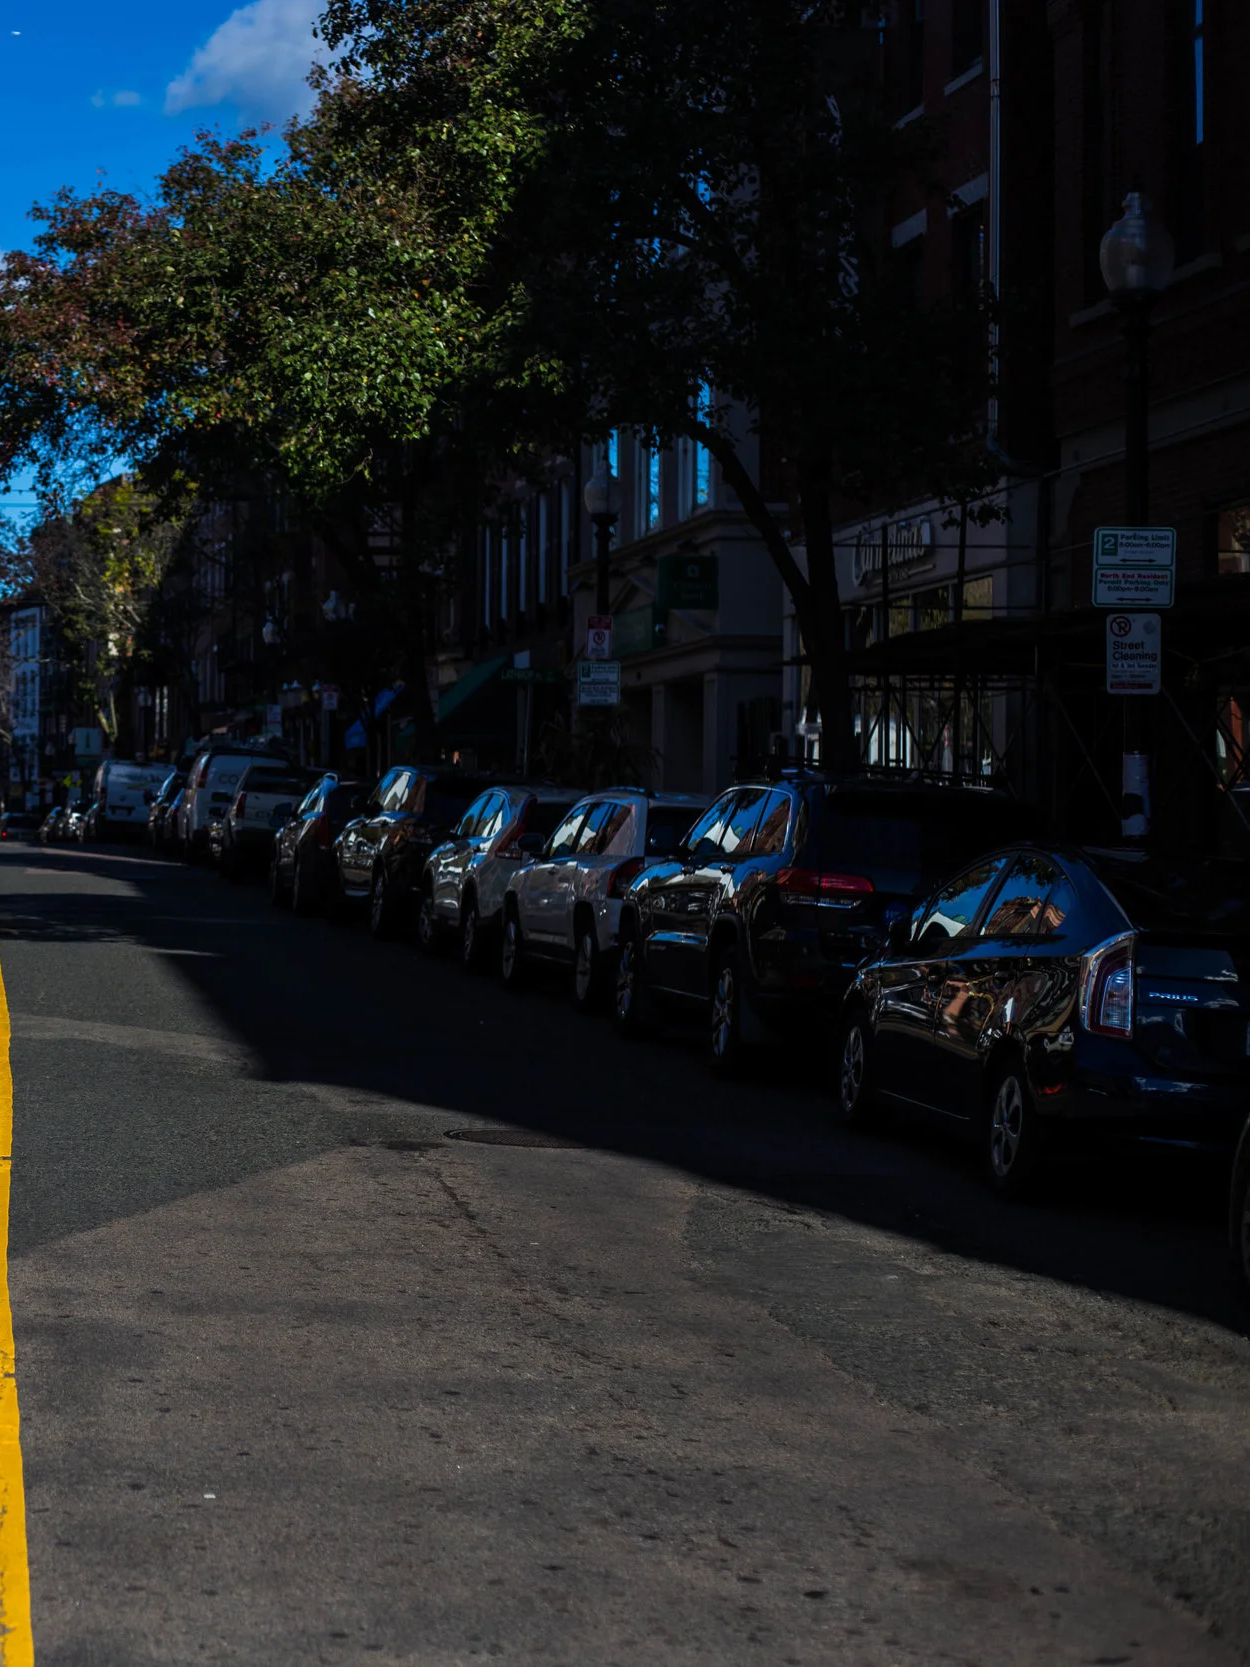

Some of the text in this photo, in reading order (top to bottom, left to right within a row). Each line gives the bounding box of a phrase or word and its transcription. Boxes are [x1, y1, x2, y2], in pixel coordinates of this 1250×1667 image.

[1120, 533, 1148, 541] Parking
[1112, 641, 1145, 650] Street
[1112, 651, 1158, 662] Cleaning
[1148, 992, 1199, 1001] PRIUS
